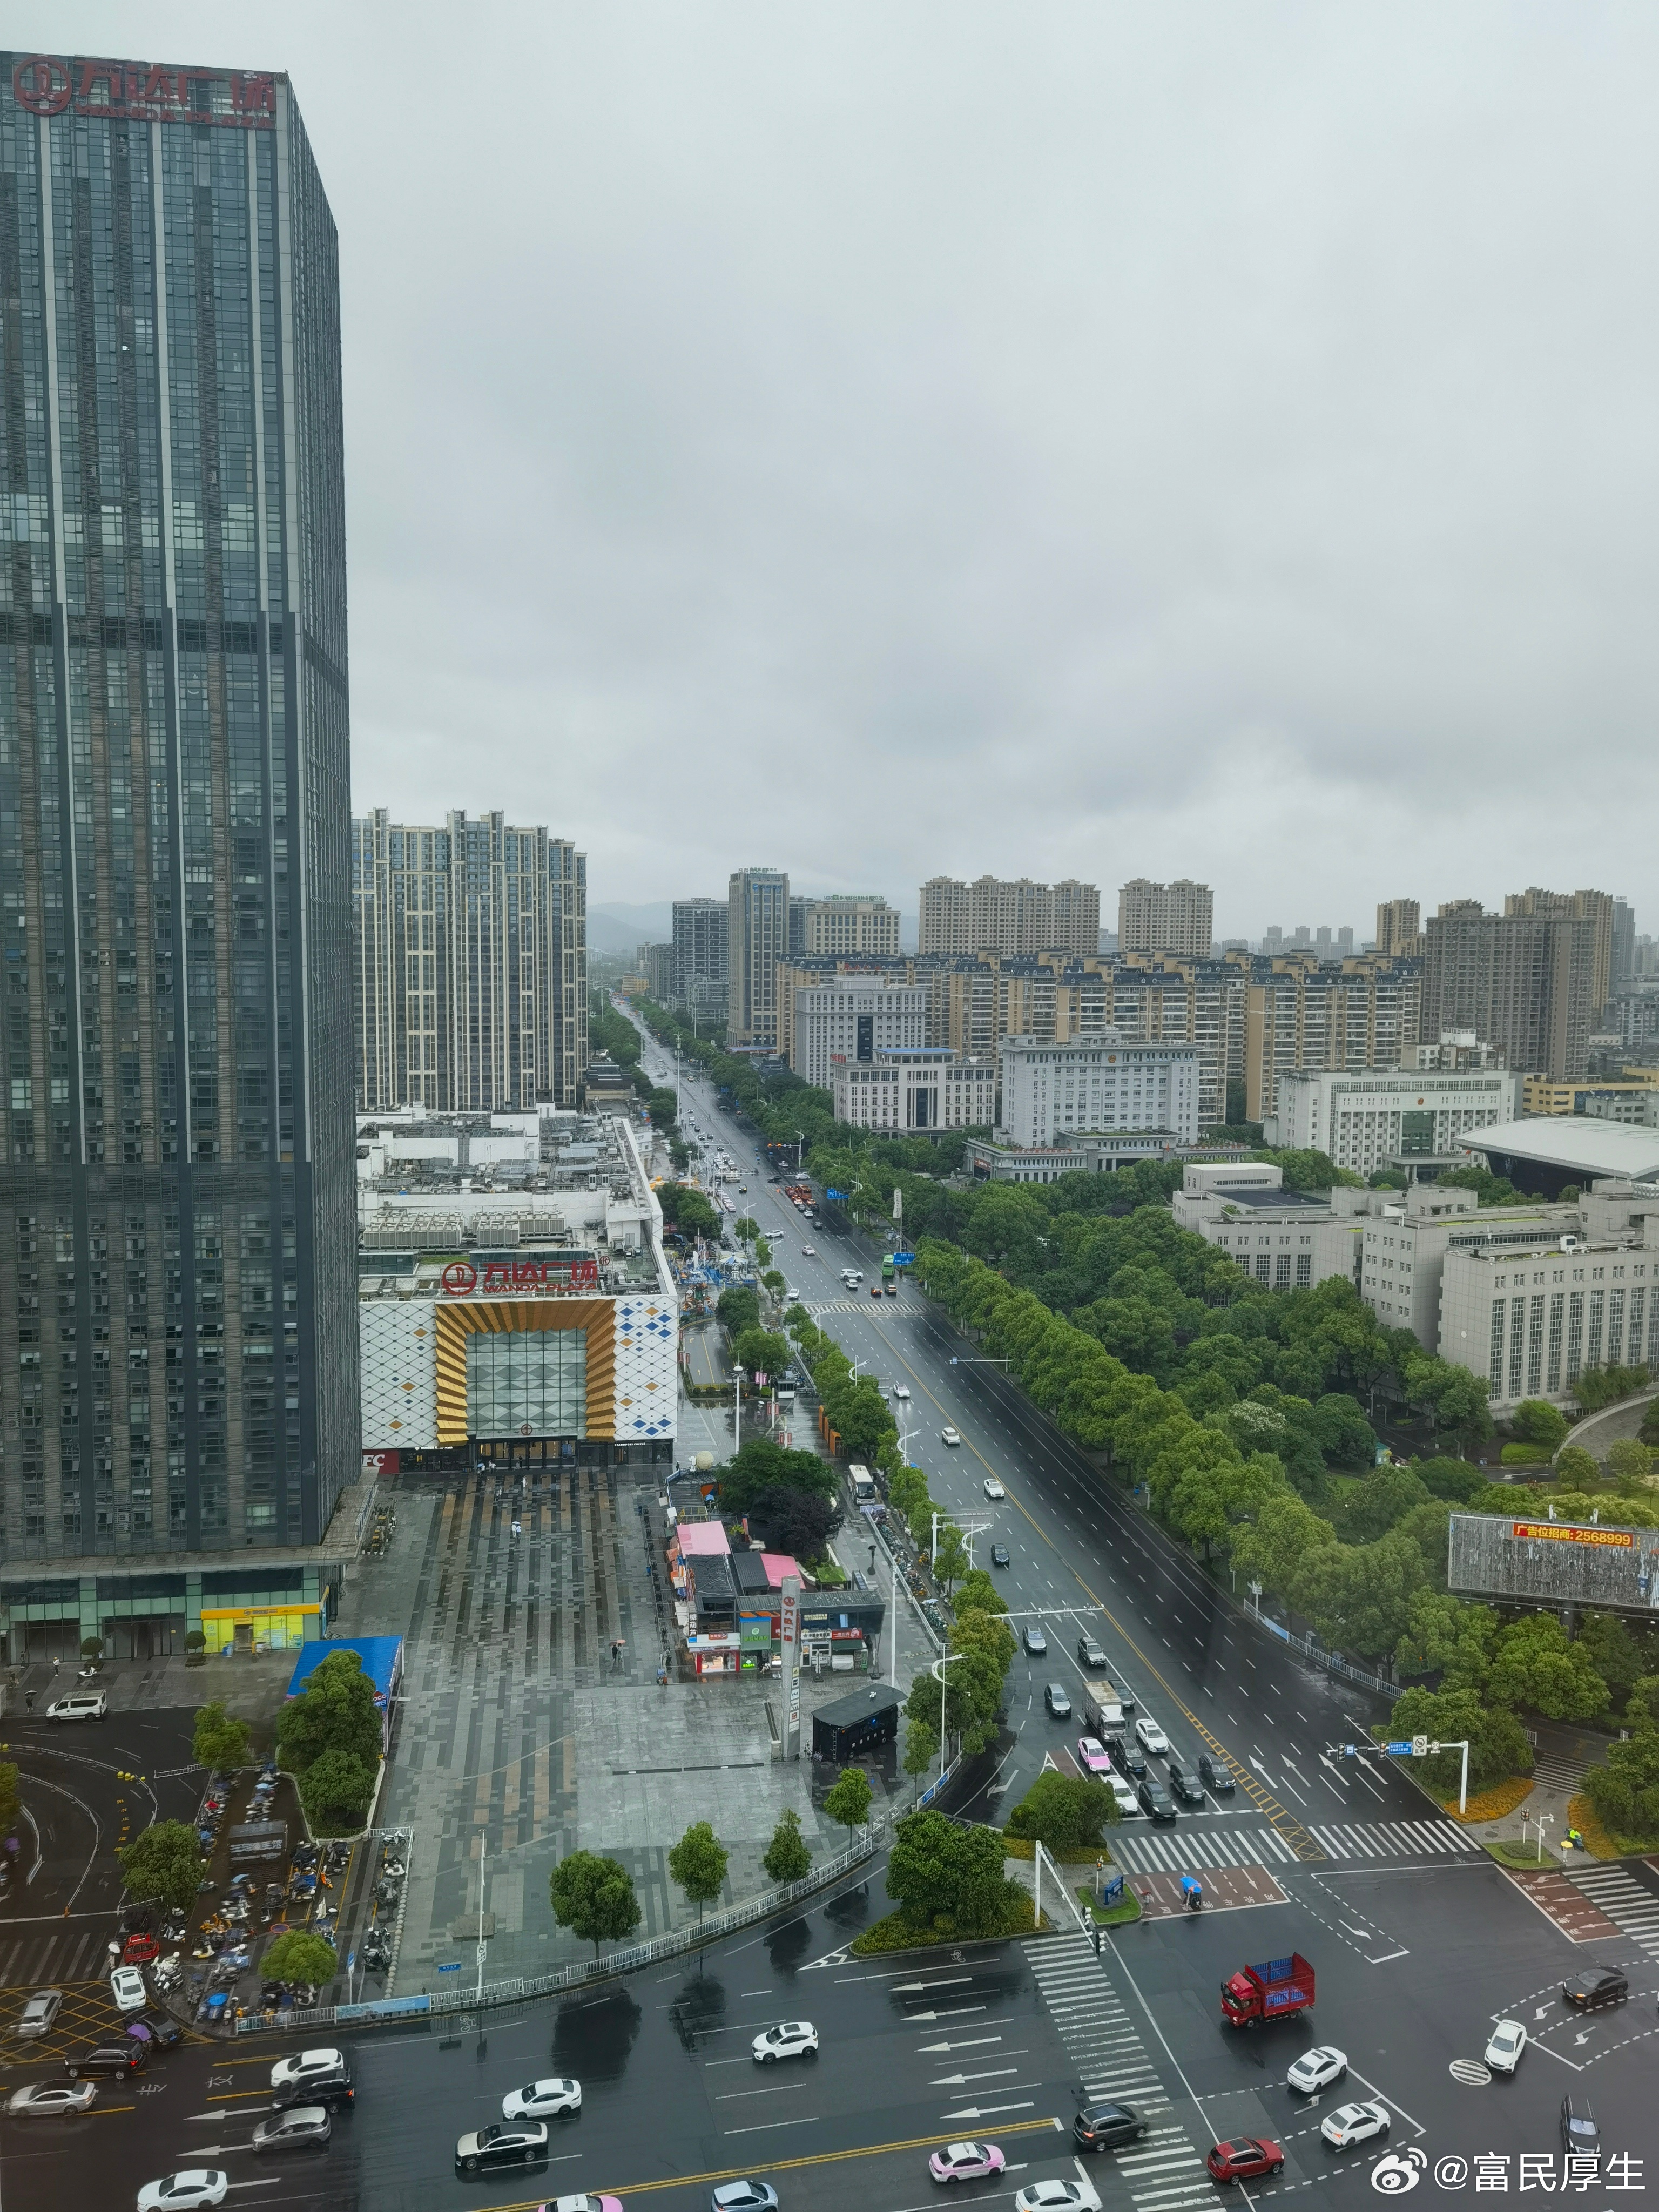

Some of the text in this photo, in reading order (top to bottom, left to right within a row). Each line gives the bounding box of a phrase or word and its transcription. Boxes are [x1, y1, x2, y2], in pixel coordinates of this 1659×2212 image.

[75, 60, 275, 111] 万达广场
[75, 103, 276, 129] WANDA PLAZA
[483, 1260, 597, 1283] 万达广场
[483, 1283, 596, 1292] WANDA PLAZA
[362, 1454, 385, 1467] FC
